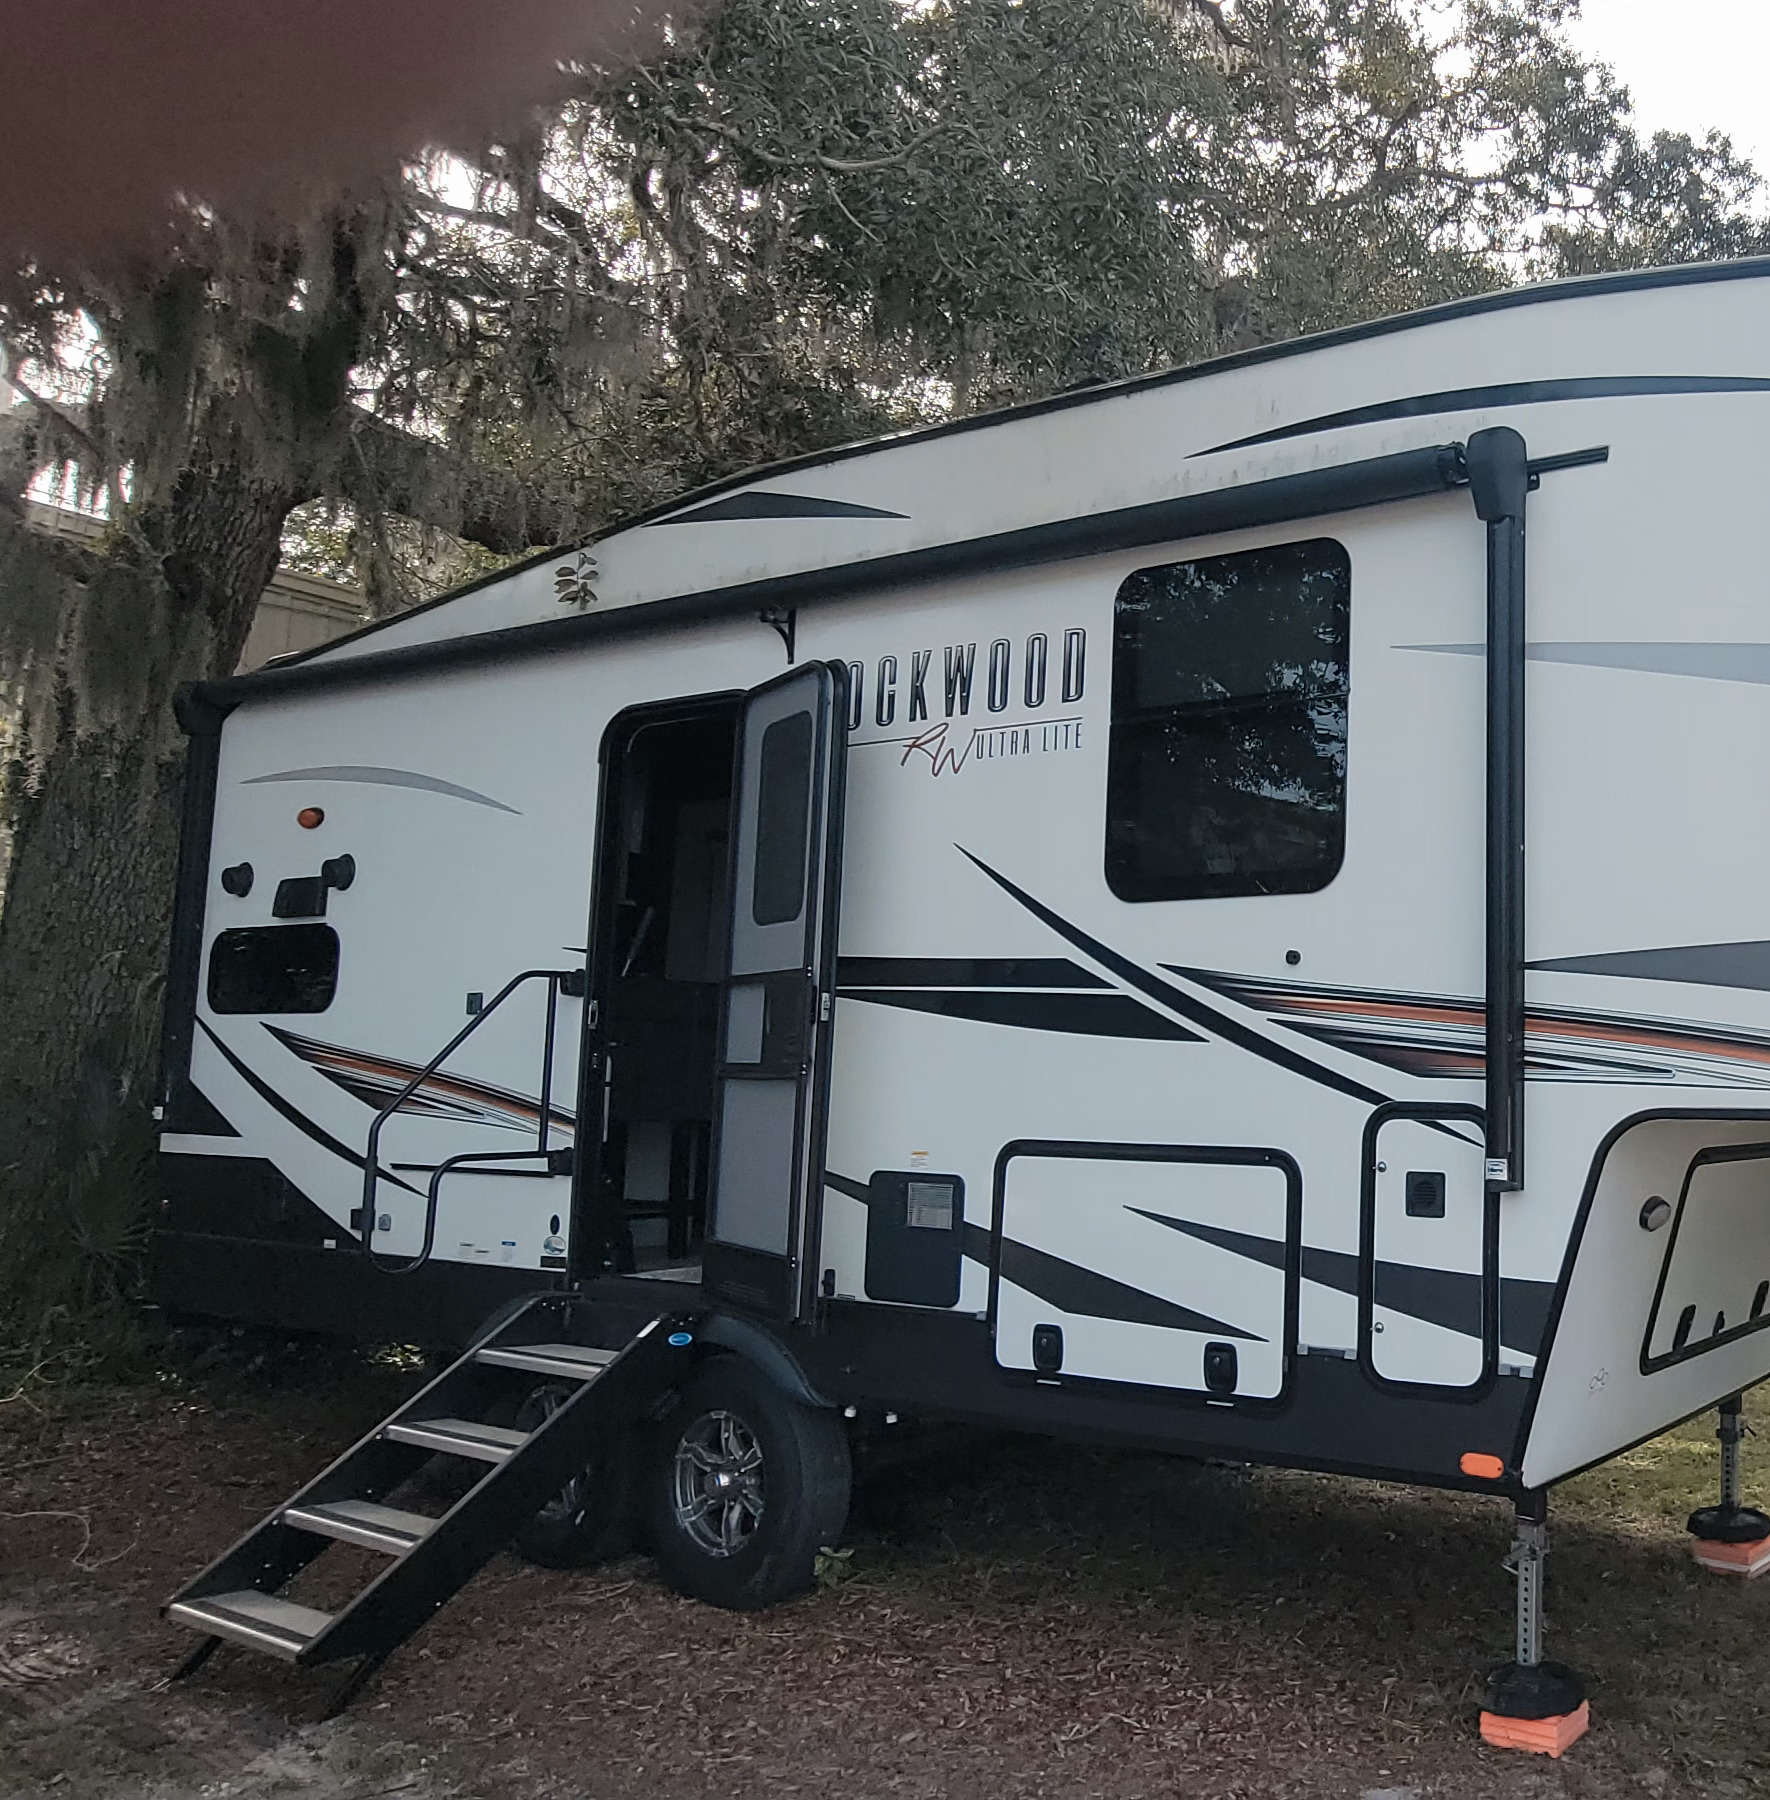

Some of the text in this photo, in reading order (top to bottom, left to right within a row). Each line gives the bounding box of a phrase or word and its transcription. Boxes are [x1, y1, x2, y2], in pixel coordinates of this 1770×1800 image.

[847, 628, 1087, 731] OCKWOOD
[976, 723, 1083, 760] ULTRA LITE
